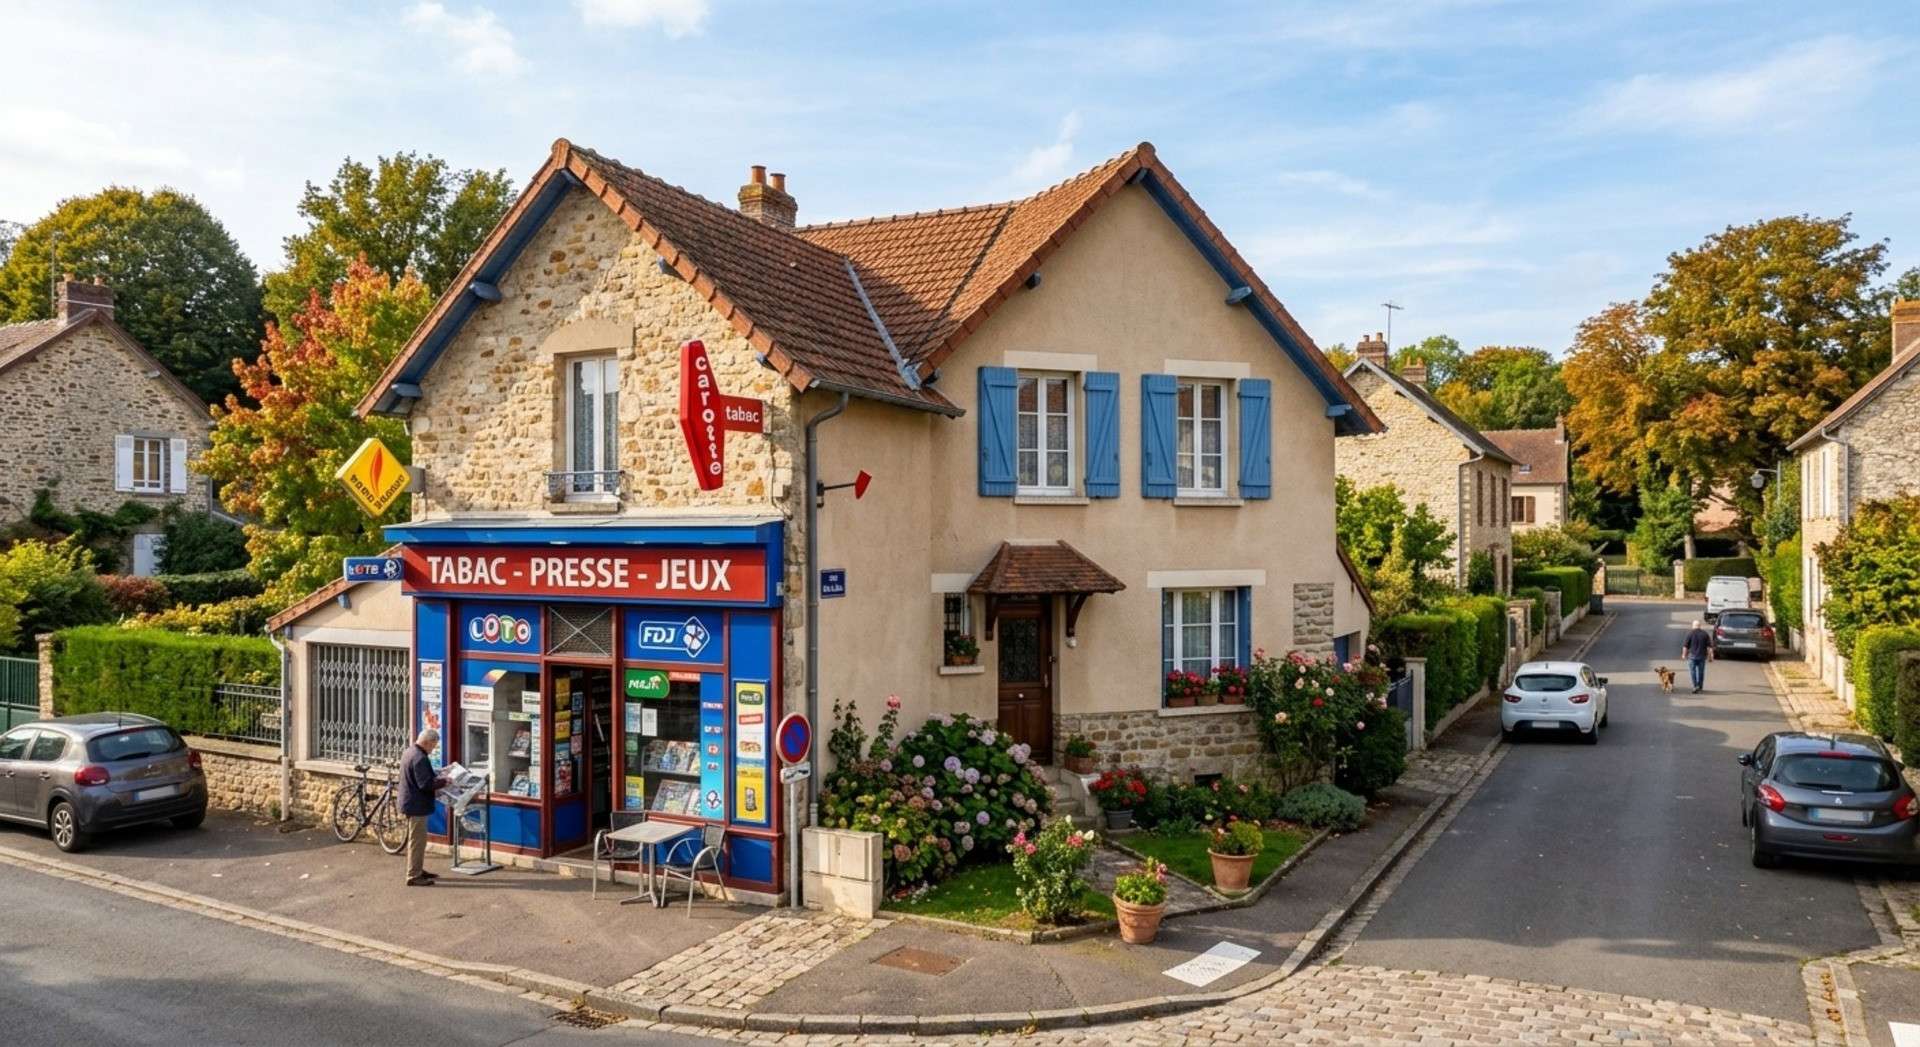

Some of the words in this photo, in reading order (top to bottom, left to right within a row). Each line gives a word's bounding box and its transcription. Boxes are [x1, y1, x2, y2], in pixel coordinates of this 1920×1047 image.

[725, 405, 760, 423] tabac
[426, 556, 507, 586] TABAC
[530, 557, 630, 588] PRESSE
[655, 559, 732, 591] JEUX
[470, 614, 531, 644] LOTO
[643, 626, 675, 644] FDJ
